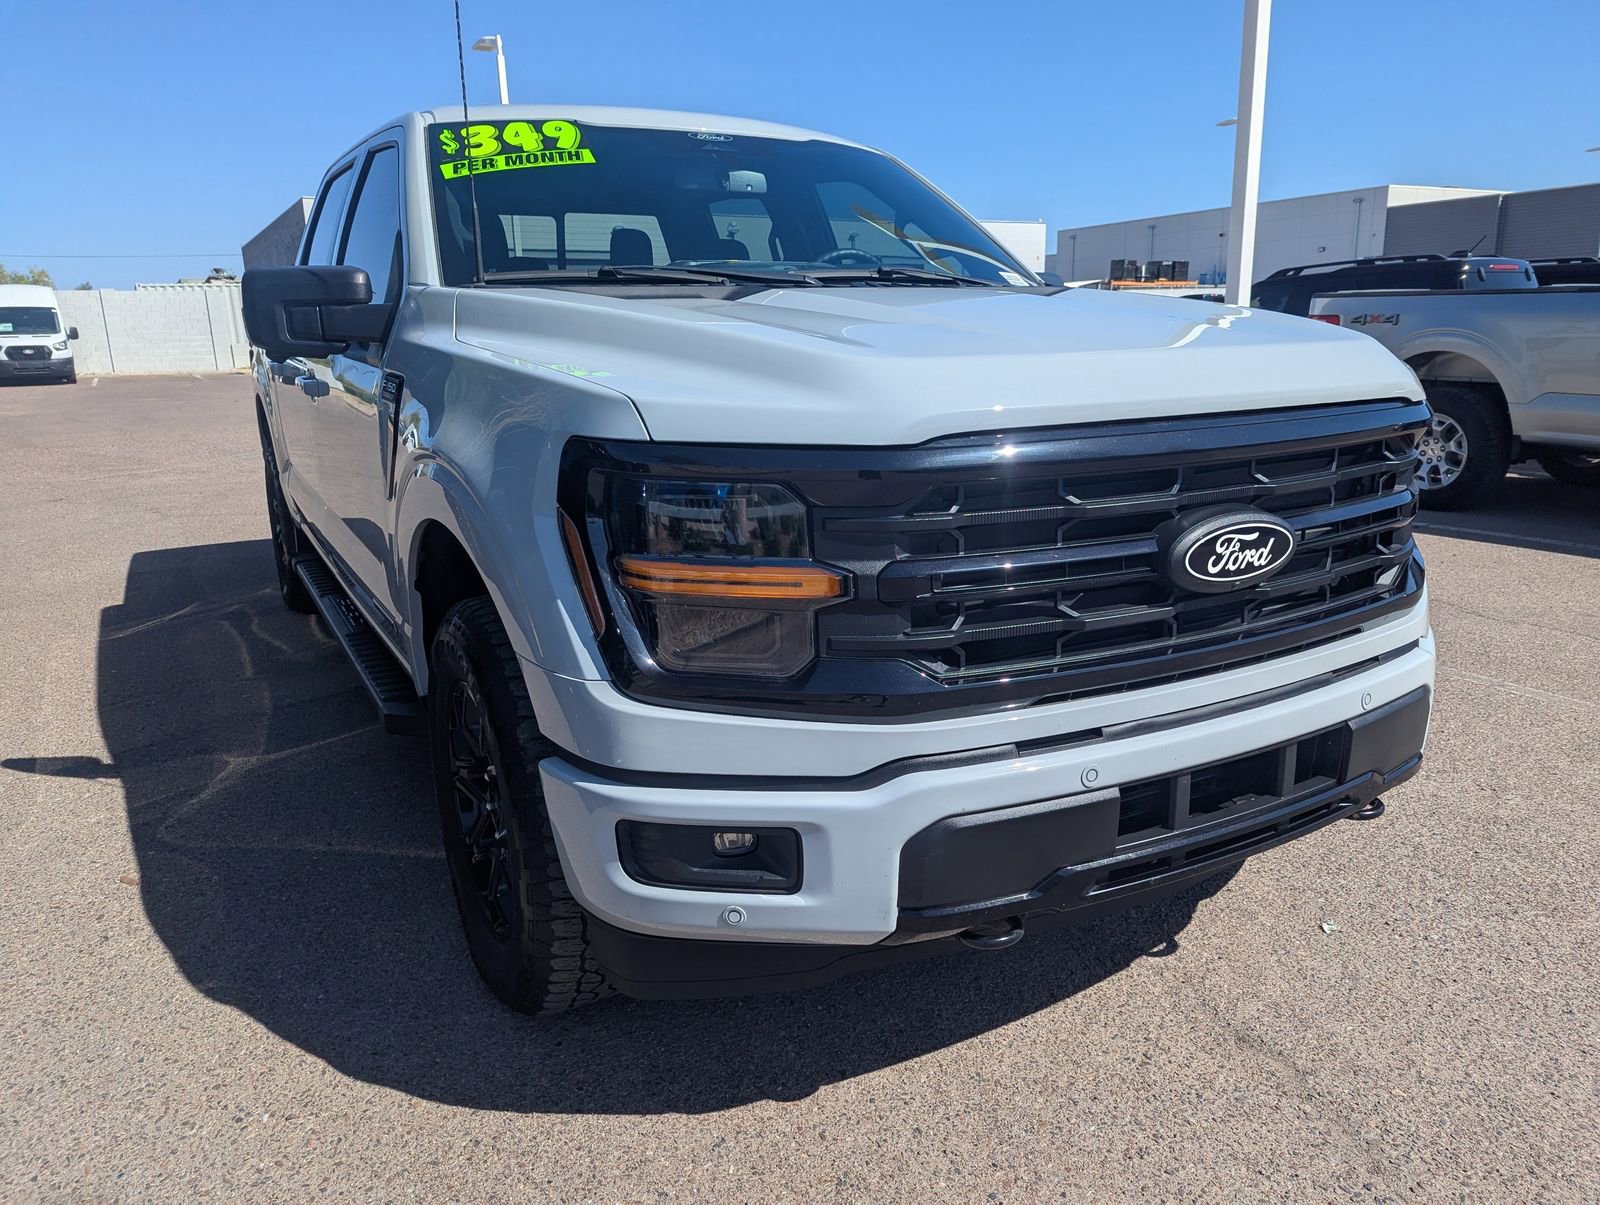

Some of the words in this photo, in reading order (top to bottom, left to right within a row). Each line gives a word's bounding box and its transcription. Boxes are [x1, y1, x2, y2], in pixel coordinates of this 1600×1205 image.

[439, 120, 581, 157] $349
[452, 157, 497, 174] PER
[504, 151, 582, 167] MONTH
[1207, 531, 1275, 574] Ford
